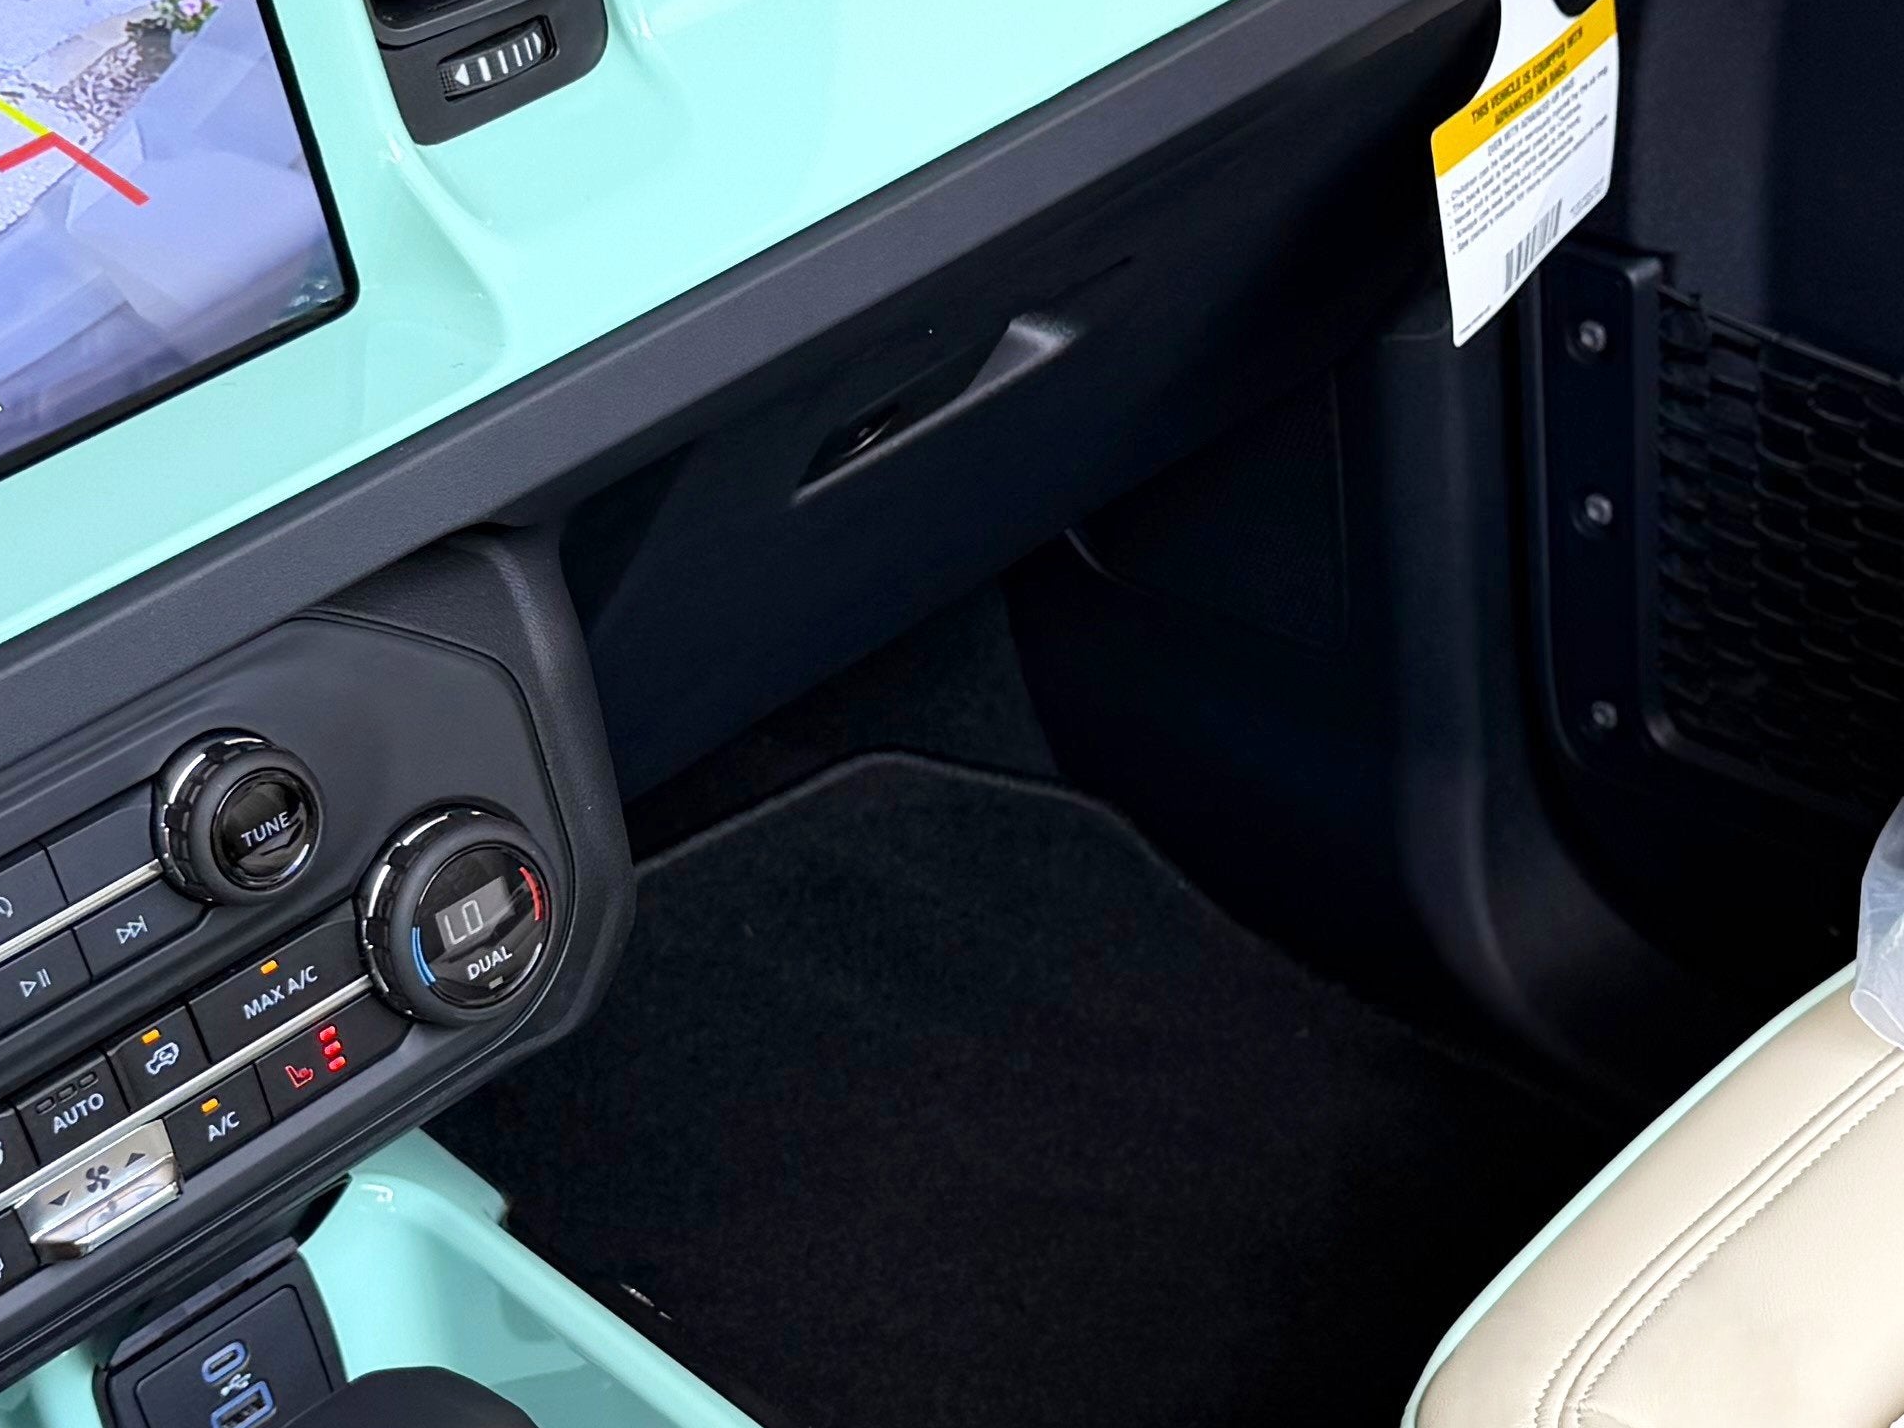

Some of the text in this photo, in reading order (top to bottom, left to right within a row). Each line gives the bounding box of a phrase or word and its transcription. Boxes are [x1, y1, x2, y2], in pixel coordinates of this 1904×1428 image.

[239, 811, 291, 848] TUNE
[467, 946, 512, 979] DUAL
[243, 964, 318, 1019] MAX A/C
[51, 1092, 105, 1133] AUTO
[205, 1111, 240, 1142] A/C
